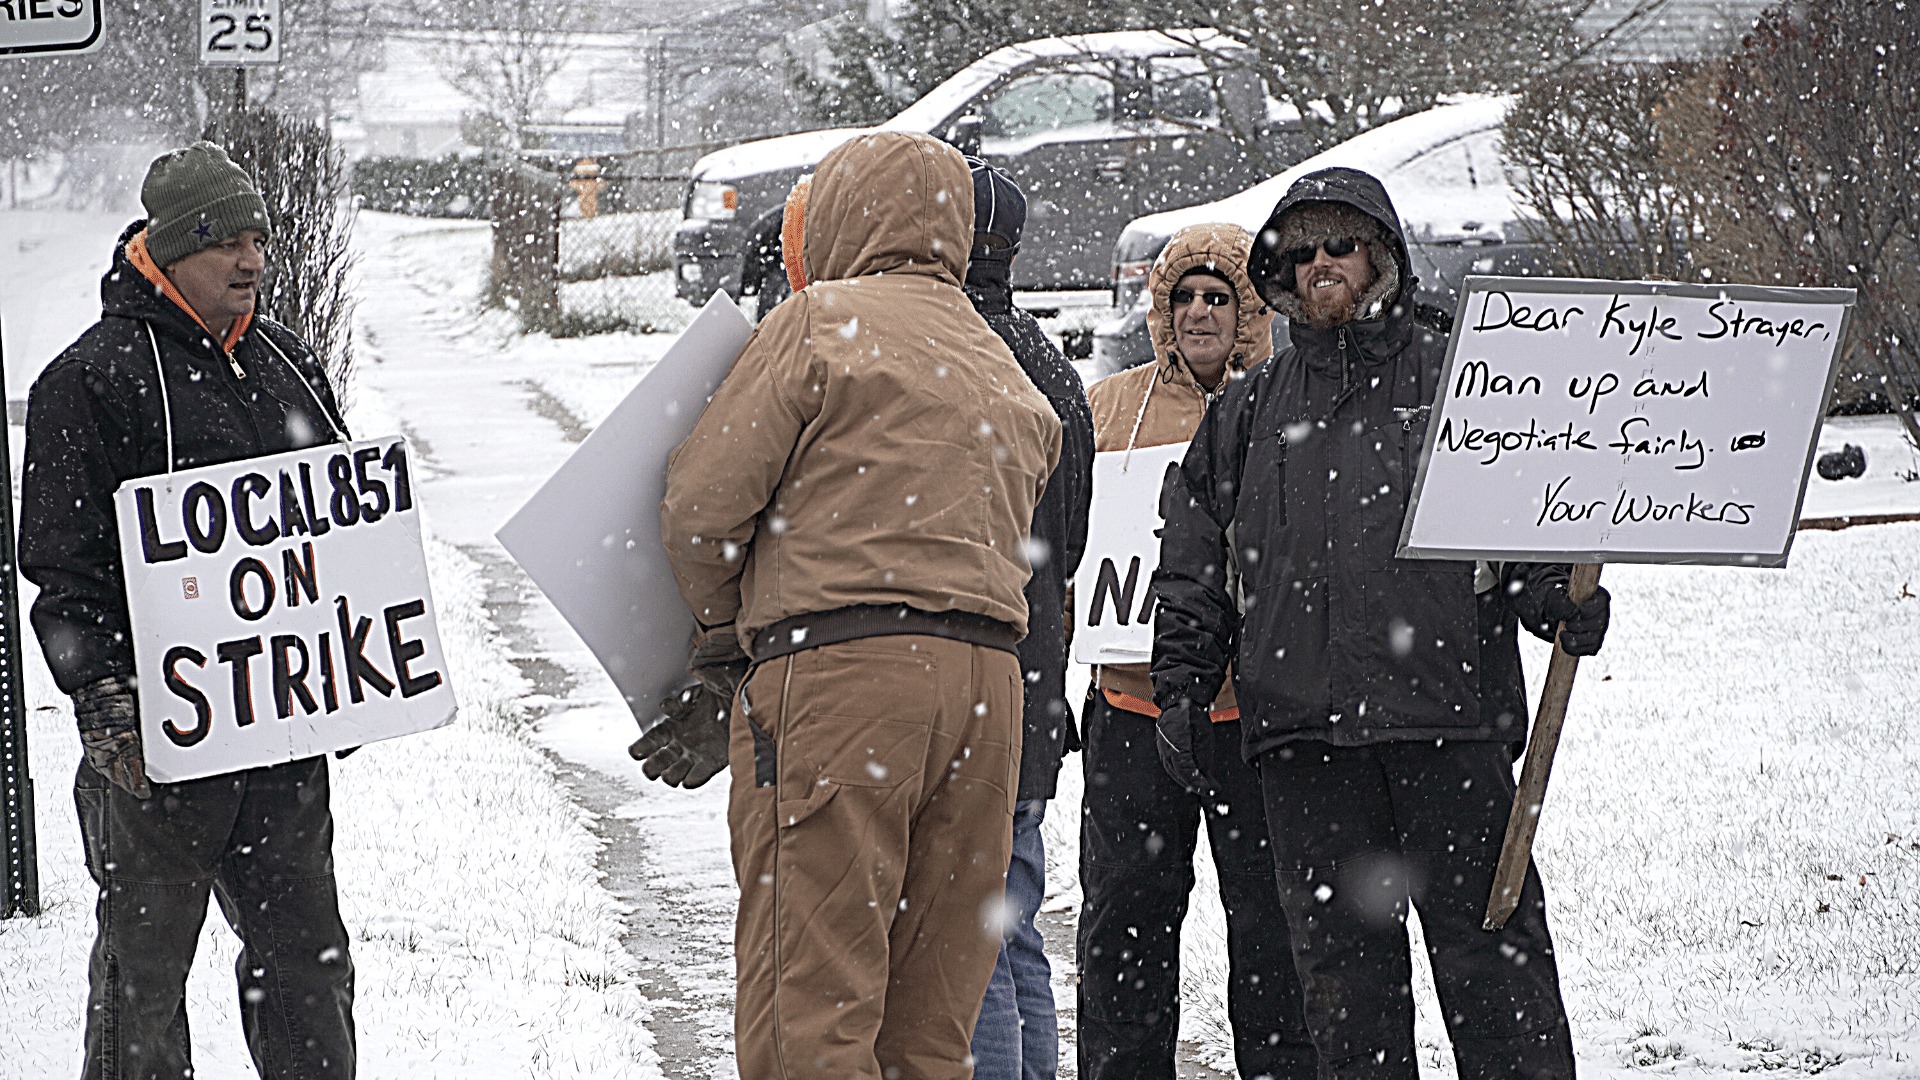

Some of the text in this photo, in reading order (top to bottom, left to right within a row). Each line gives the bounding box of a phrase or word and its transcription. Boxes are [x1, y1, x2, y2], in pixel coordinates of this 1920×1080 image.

[208, 14, 272, 51] 25
[1472, 290, 1830, 355] Dear Kyle Strayer,
[1454, 360, 1709, 414] Man up and
[1437, 417, 1597, 465] Negotiate
[1609, 417, 1714, 470] fairly.
[134, 441, 413, 565] LOCAL 851
[1536, 476, 1755, 527] Your Workers
[229, 540, 320, 622] ON
[161, 595, 443, 749] STRIKE
